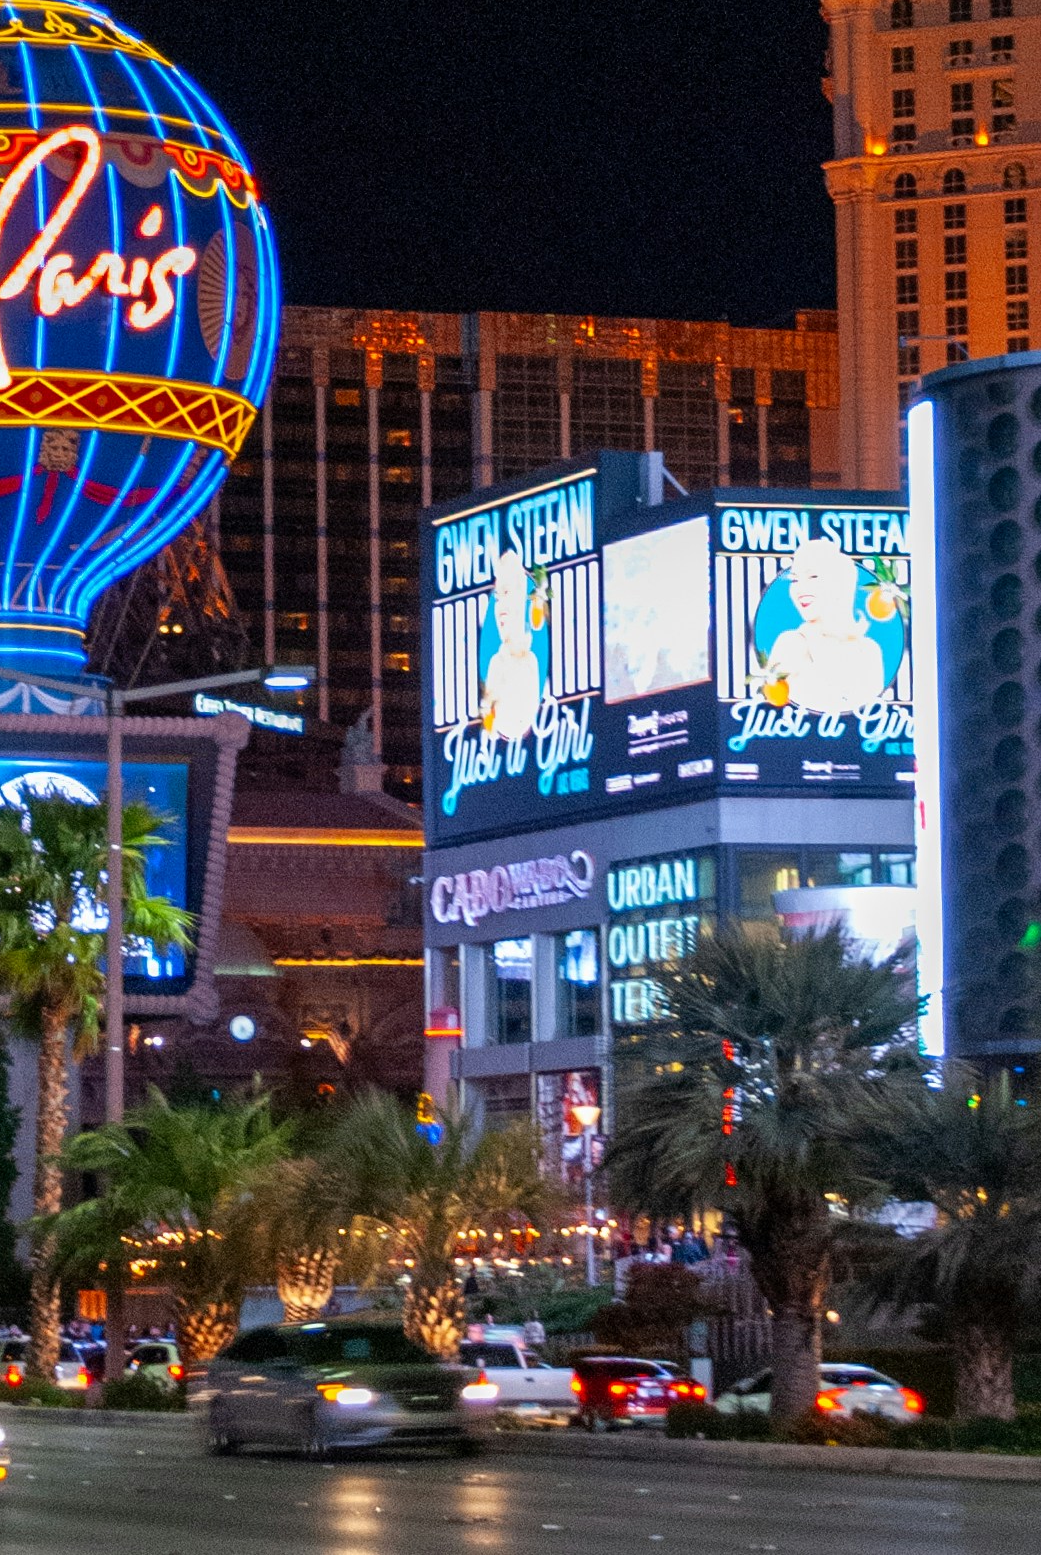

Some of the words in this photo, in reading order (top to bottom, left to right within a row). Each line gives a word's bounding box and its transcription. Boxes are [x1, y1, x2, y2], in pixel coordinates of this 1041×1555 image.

[437, 510, 500, 594] GWEN
[507, 480, 594, 569] STEFANI
[721, 509, 810, 552] GWEN
[727, 702, 811, 752] Just
[817, 708, 846, 738] a
[442, 718, 502, 816] Just
[506, 737, 527, 776] a
[533, 695, 594, 795] Girl
[607, 858, 698, 912] URBAN
[608, 916, 700, 968] OUTFIT
